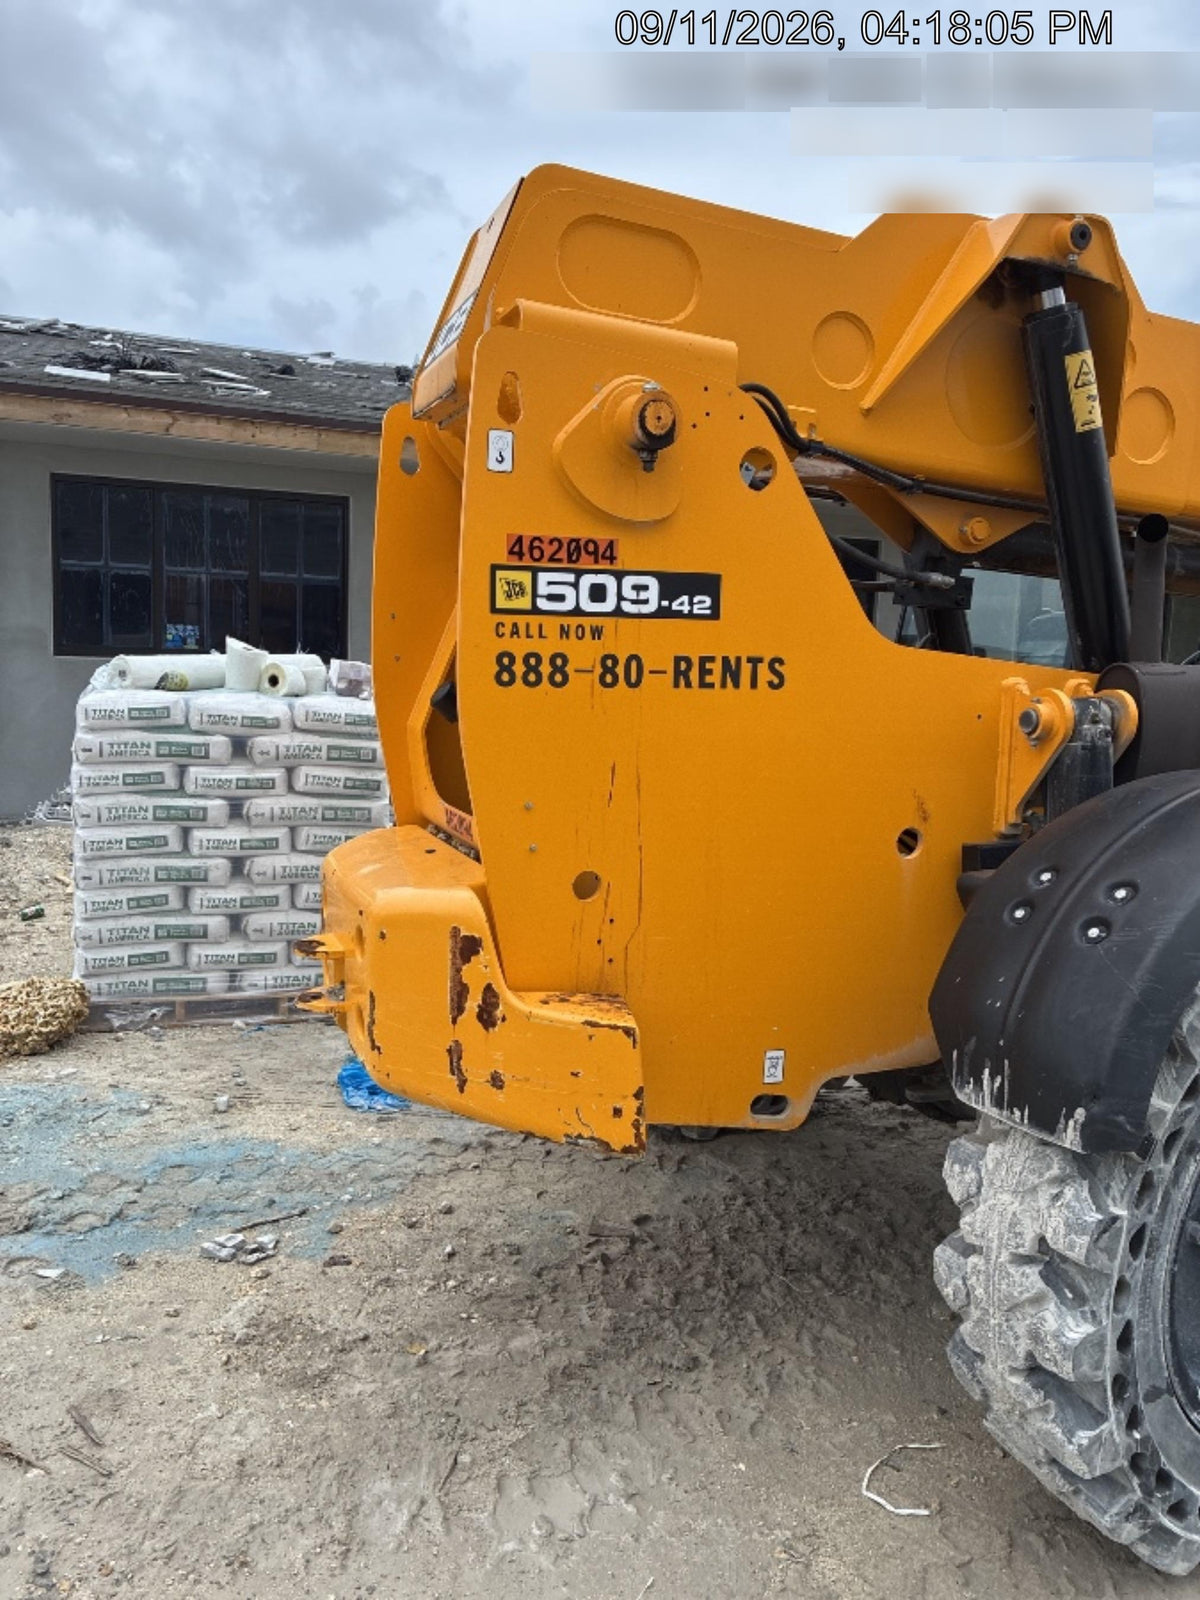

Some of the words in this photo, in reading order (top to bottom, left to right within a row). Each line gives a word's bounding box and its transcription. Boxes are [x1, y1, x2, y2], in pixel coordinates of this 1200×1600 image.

[507, 534, 617, 565] 462094
[494, 621, 548, 640] CALL
[559, 623, 604, 641] NOW
[494, 650, 786, 691] 888-80-RENTS
[107, 742, 151, 750] TITAN
[284, 744, 323, 753] TITAN
[105, 806, 149, 814] TITAN
[278, 806, 319, 815] TITAN
[106, 867, 150, 877] TITAN
[277, 922, 317, 930] TITAN
[106, 926, 150, 936] TITAN
[272, 974, 312, 983] TITAN
[105, 979, 149, 989] TITAN
